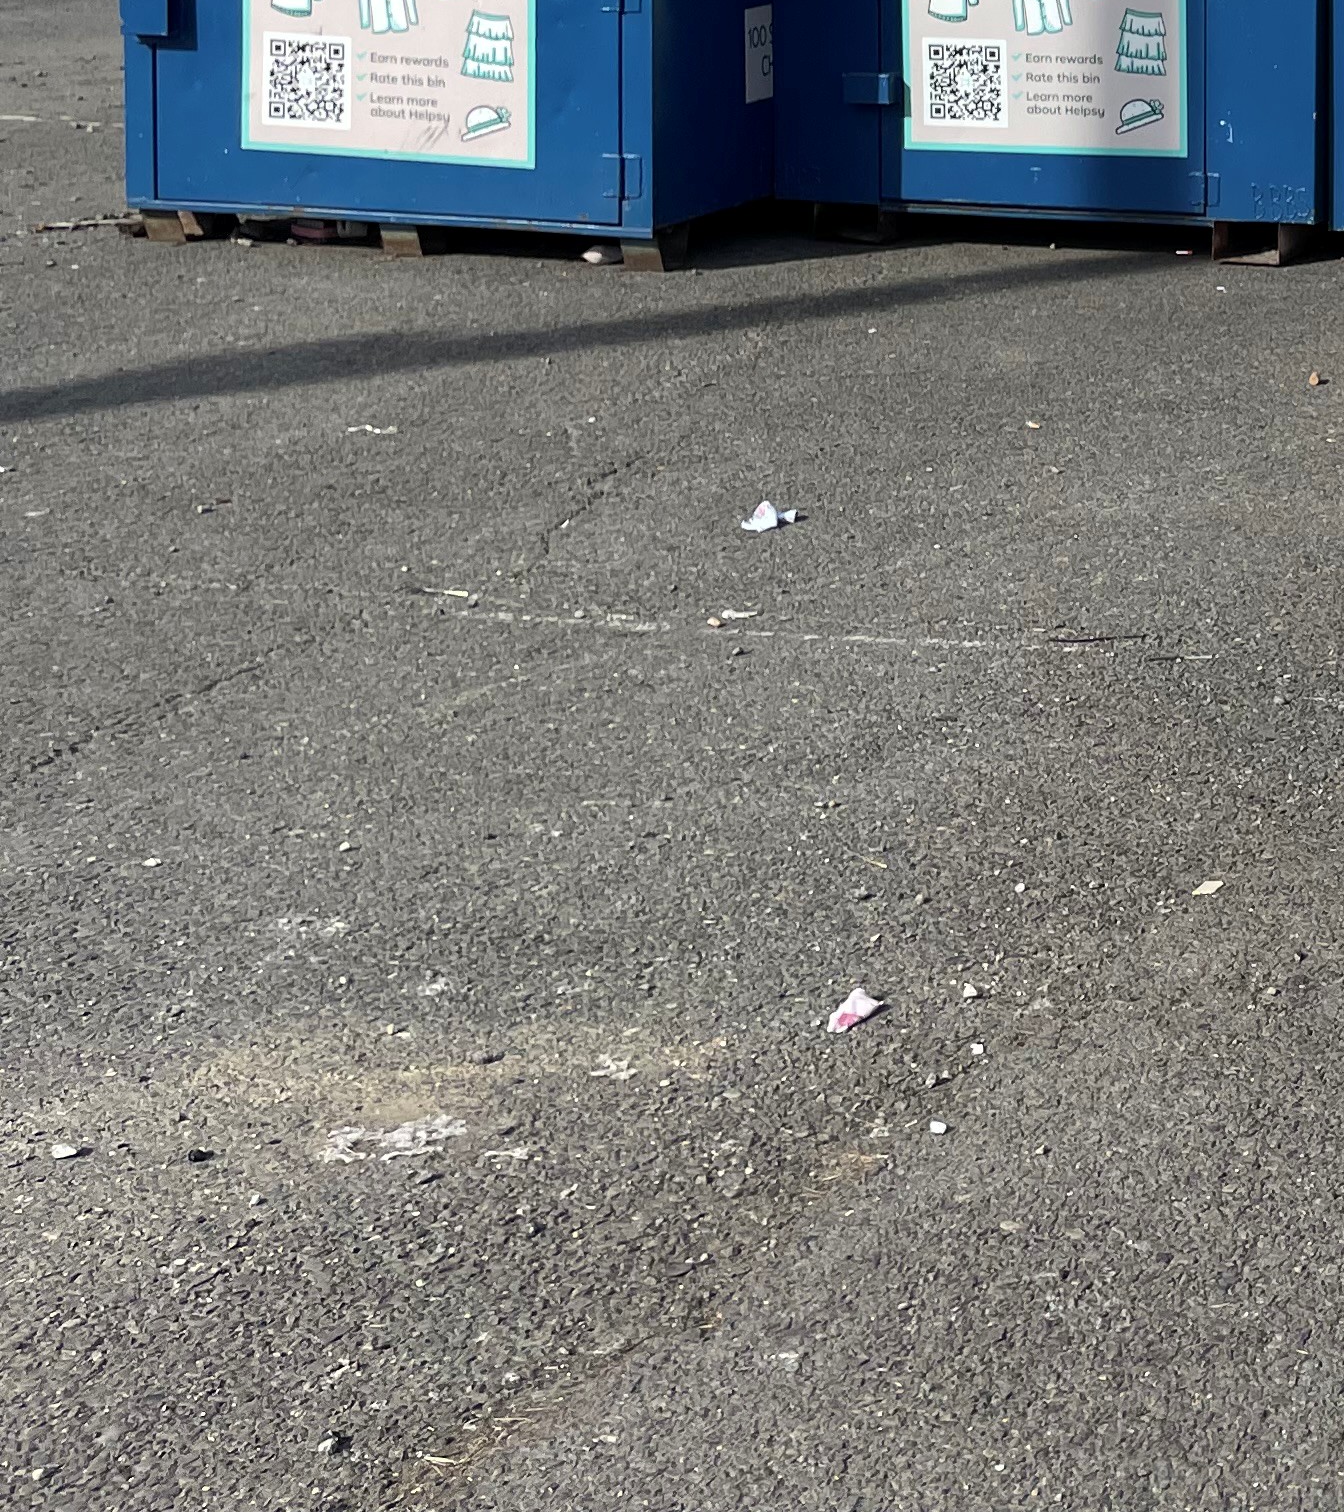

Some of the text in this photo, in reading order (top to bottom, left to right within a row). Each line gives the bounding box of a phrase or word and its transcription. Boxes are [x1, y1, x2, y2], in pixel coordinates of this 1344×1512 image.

[370, 52, 449, 69] Earn rewards
[1025, 53, 1104, 66] Earn rewards
[370, 73, 446, 88] Rate this bin
[1025, 72, 1100, 84] Rate this bin
[370, 93, 438, 107] Learn more
[1026, 92, 1093, 103] Learn more
[371, 108, 450, 125] about Helpsy
[1026, 105, 1105, 119] about Helpsy
